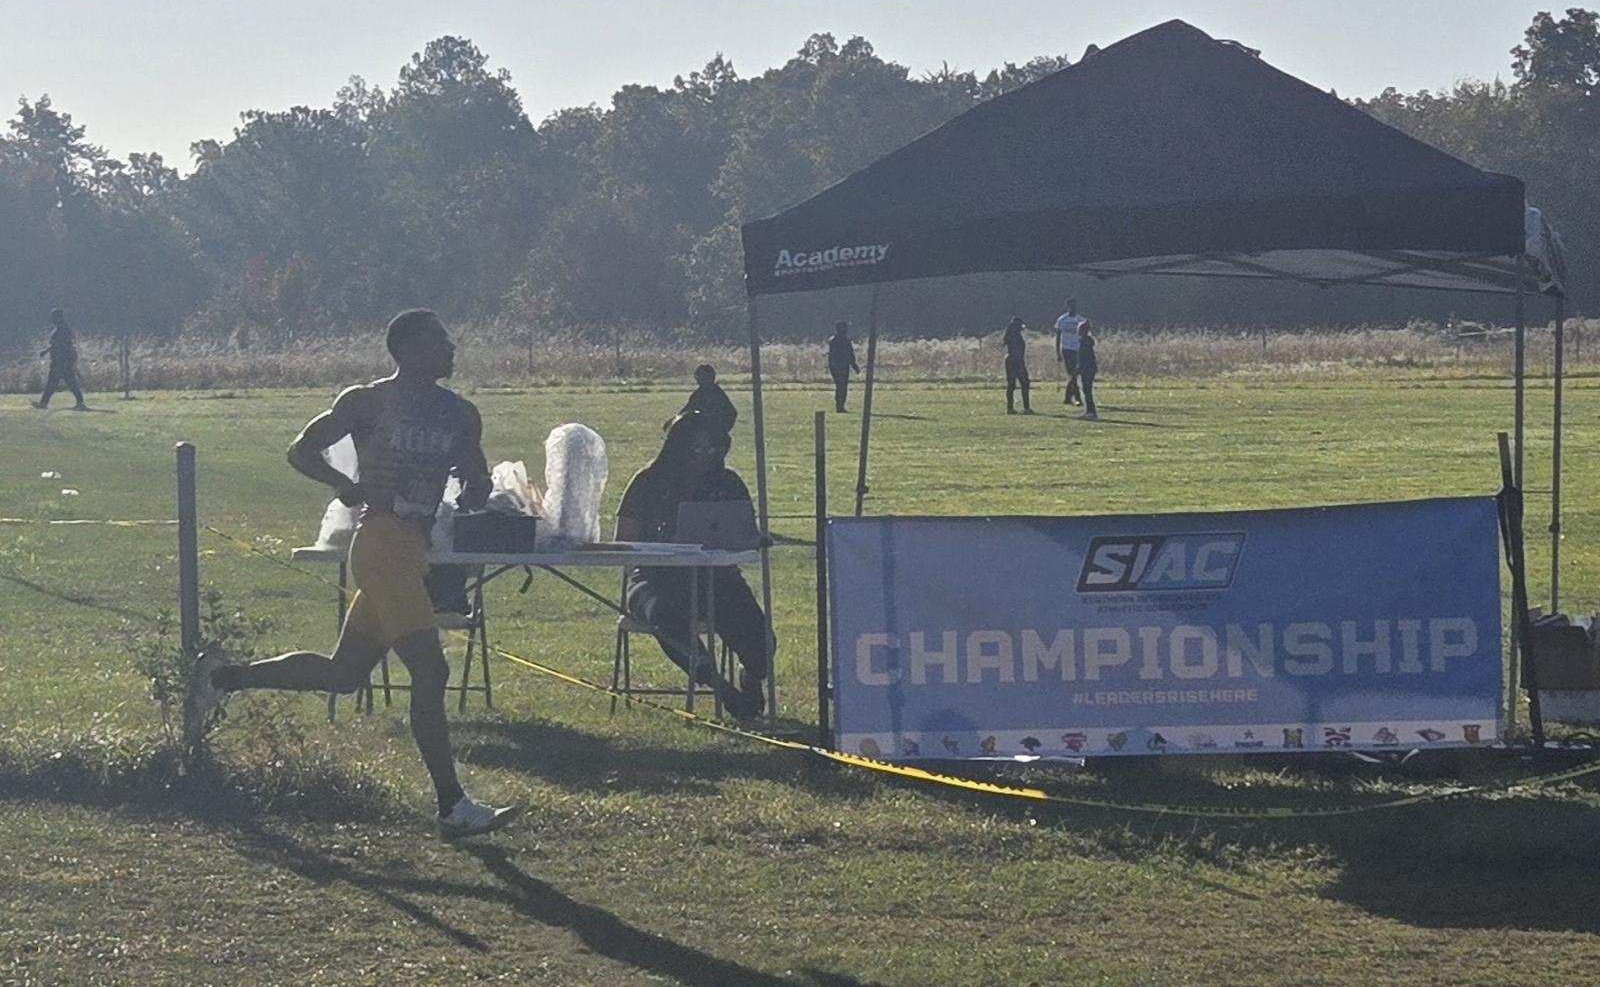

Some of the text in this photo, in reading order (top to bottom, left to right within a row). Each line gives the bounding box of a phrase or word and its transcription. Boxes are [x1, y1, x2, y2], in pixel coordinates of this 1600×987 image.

[774, 244, 889, 268] Academy
[1086, 541, 1236, 585] SIAC
[855, 617, 1478, 686] CHAMPIONSHIP
[1073, 689, 1258, 704] #LEADERSRISEHERE
